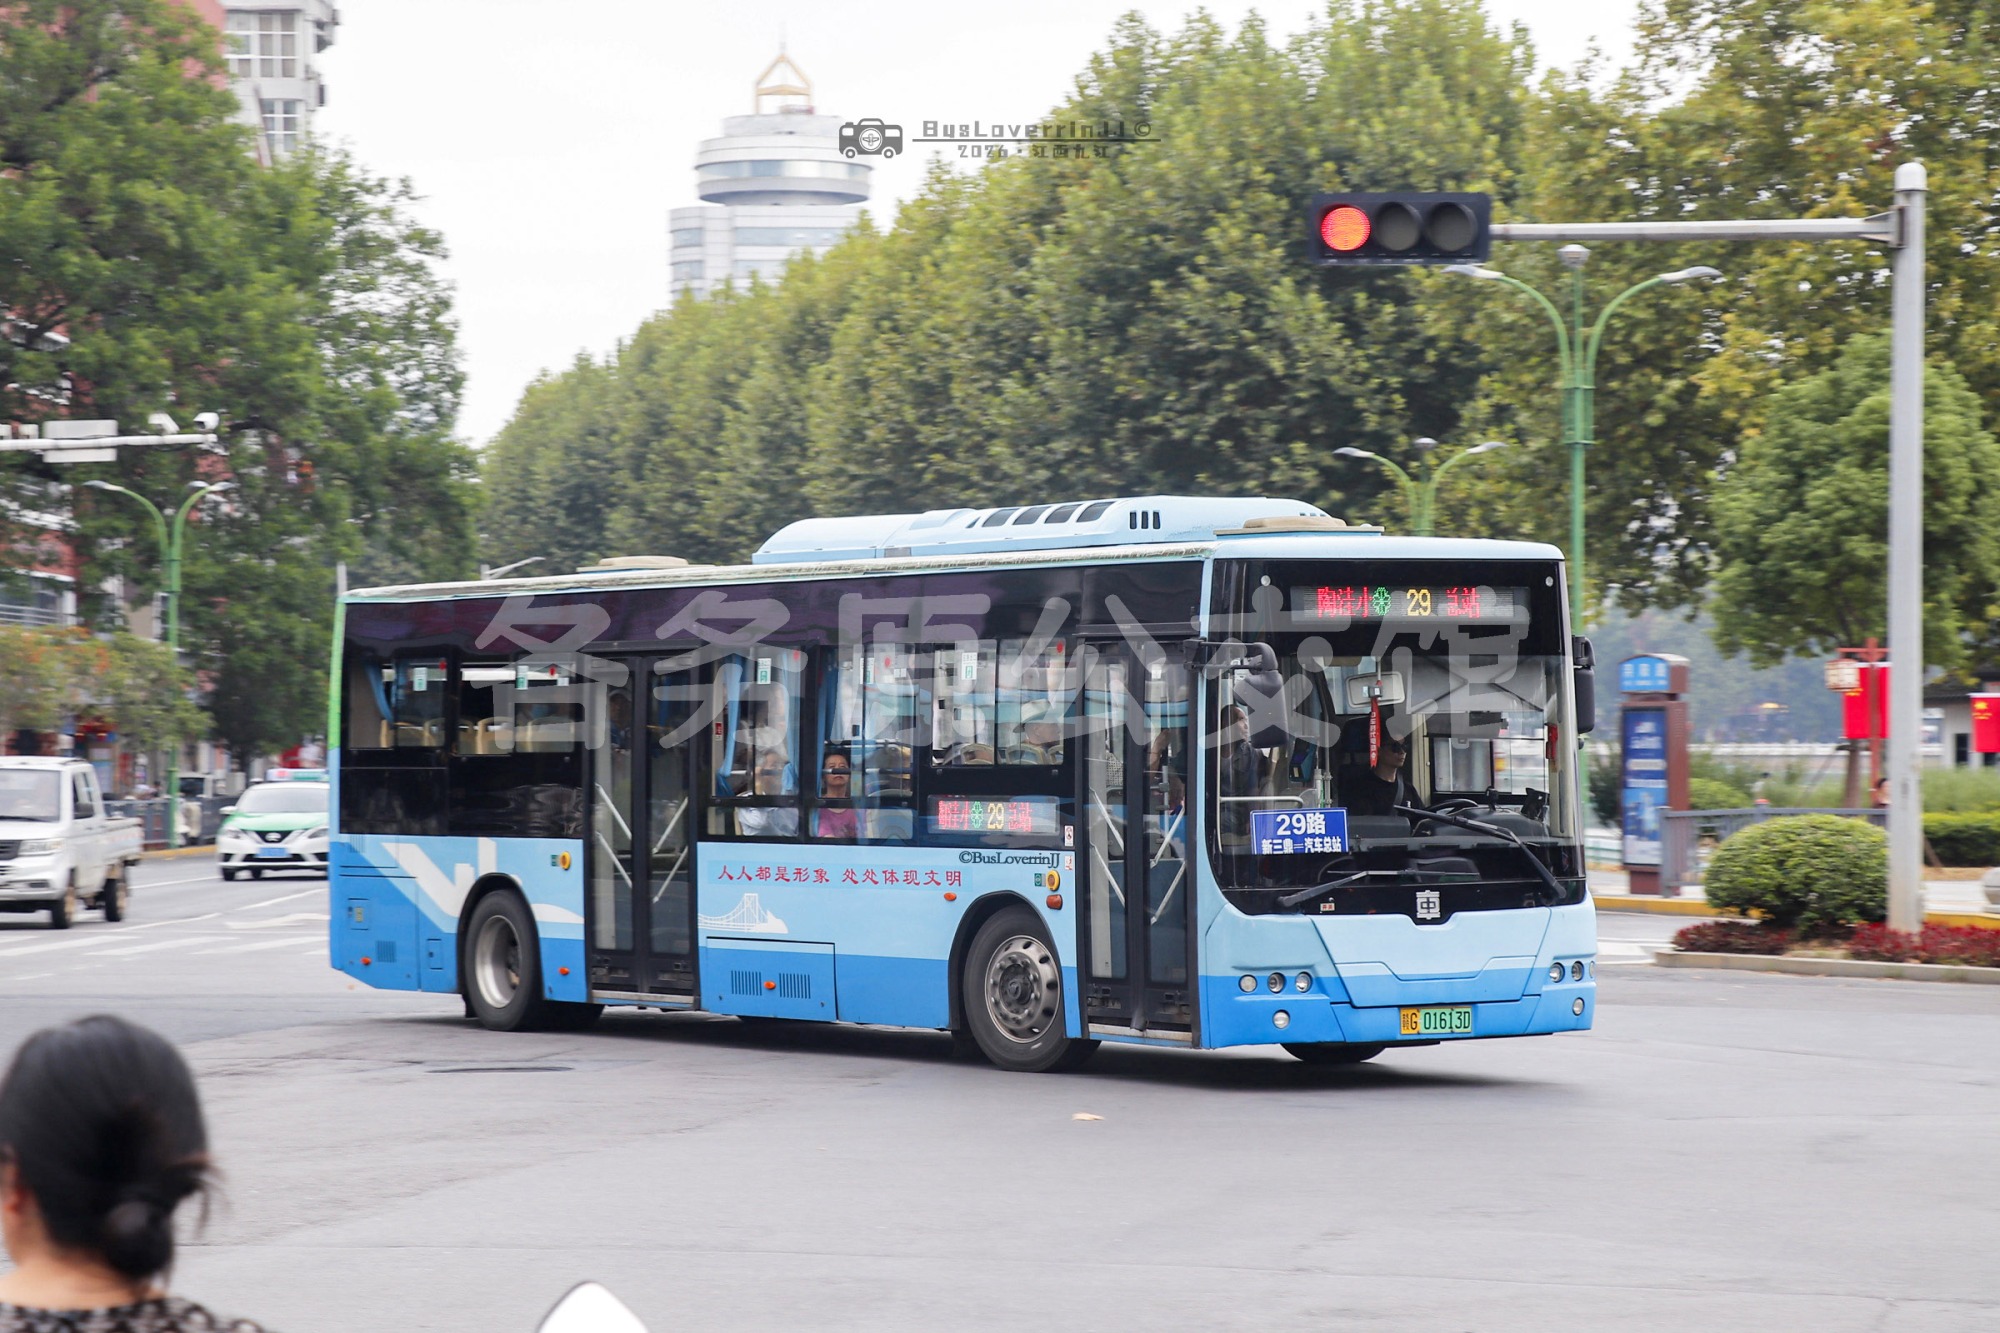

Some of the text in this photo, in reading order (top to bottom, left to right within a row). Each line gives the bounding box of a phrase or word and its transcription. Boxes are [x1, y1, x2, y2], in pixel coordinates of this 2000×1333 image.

[1406, 588, 1431, 616] 29
[1446, 587, 1480, 618] 总站
[987, 803, 1005, 829] 29
[1276, 812, 1325, 836] 29路
[718, 865, 962, 887] 人人都是形象 处处体现文明
